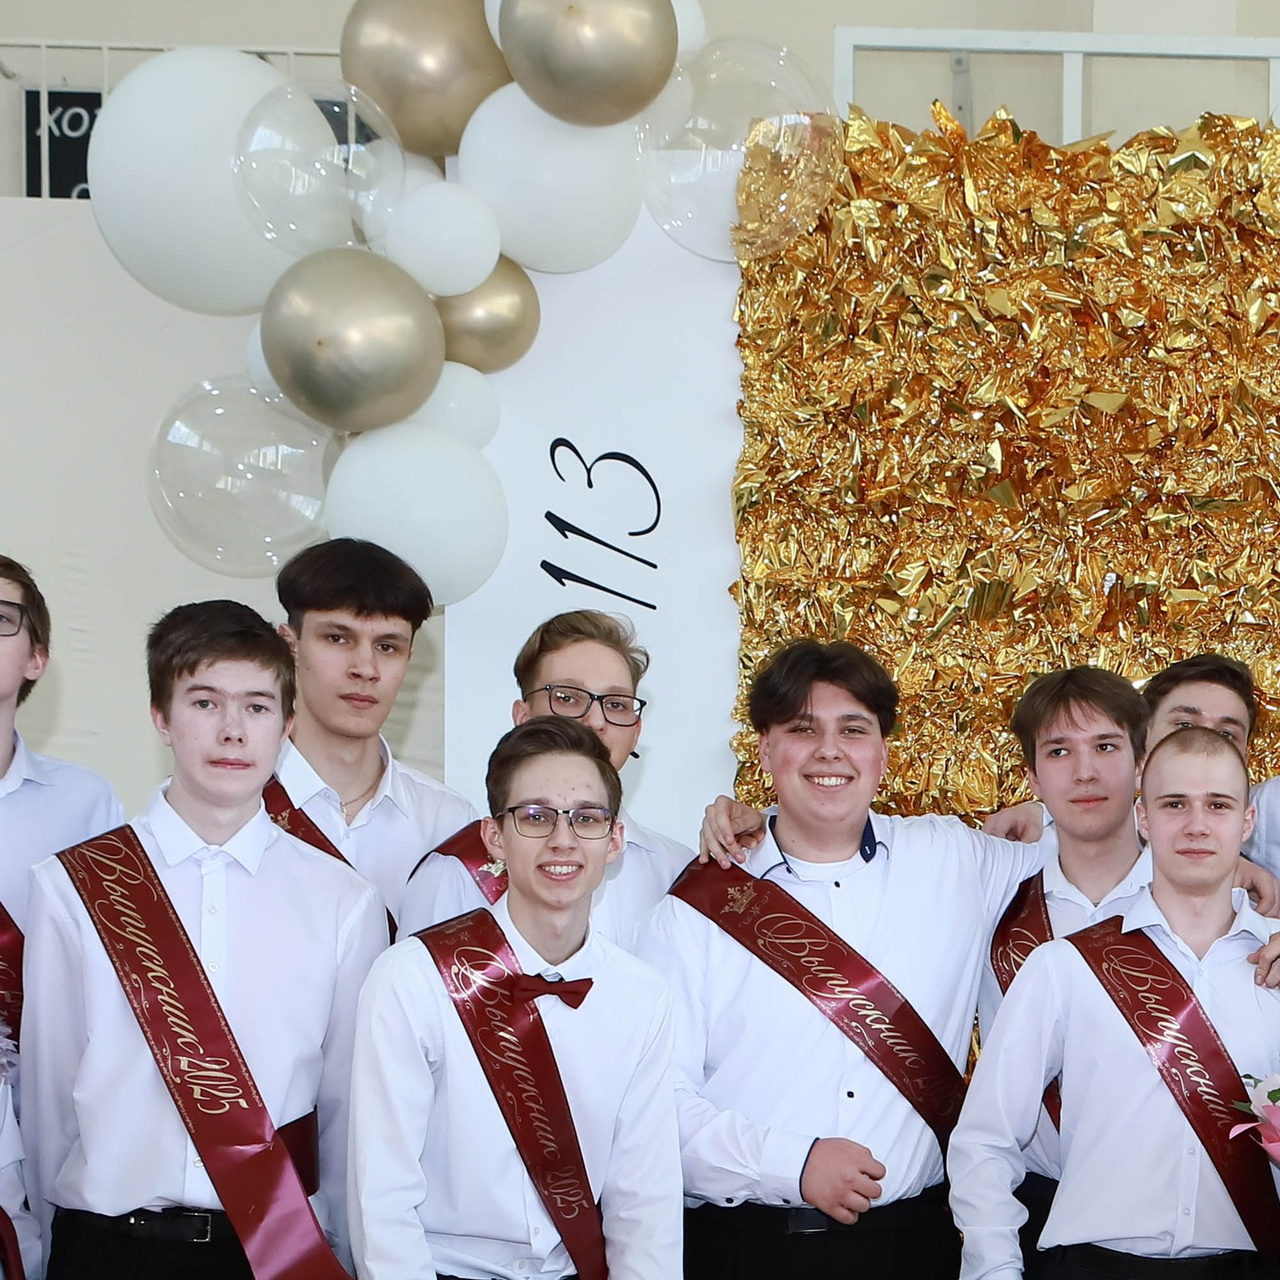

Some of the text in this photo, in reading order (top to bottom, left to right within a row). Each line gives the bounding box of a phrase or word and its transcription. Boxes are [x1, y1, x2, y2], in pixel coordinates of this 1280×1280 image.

[540, 437, 661, 610] 113
[74, 834, 250, 1115] Выпускник 2025
[450, 946, 590, 1219] Выпускник 2025
[754, 913, 926, 1069] Выпускник
